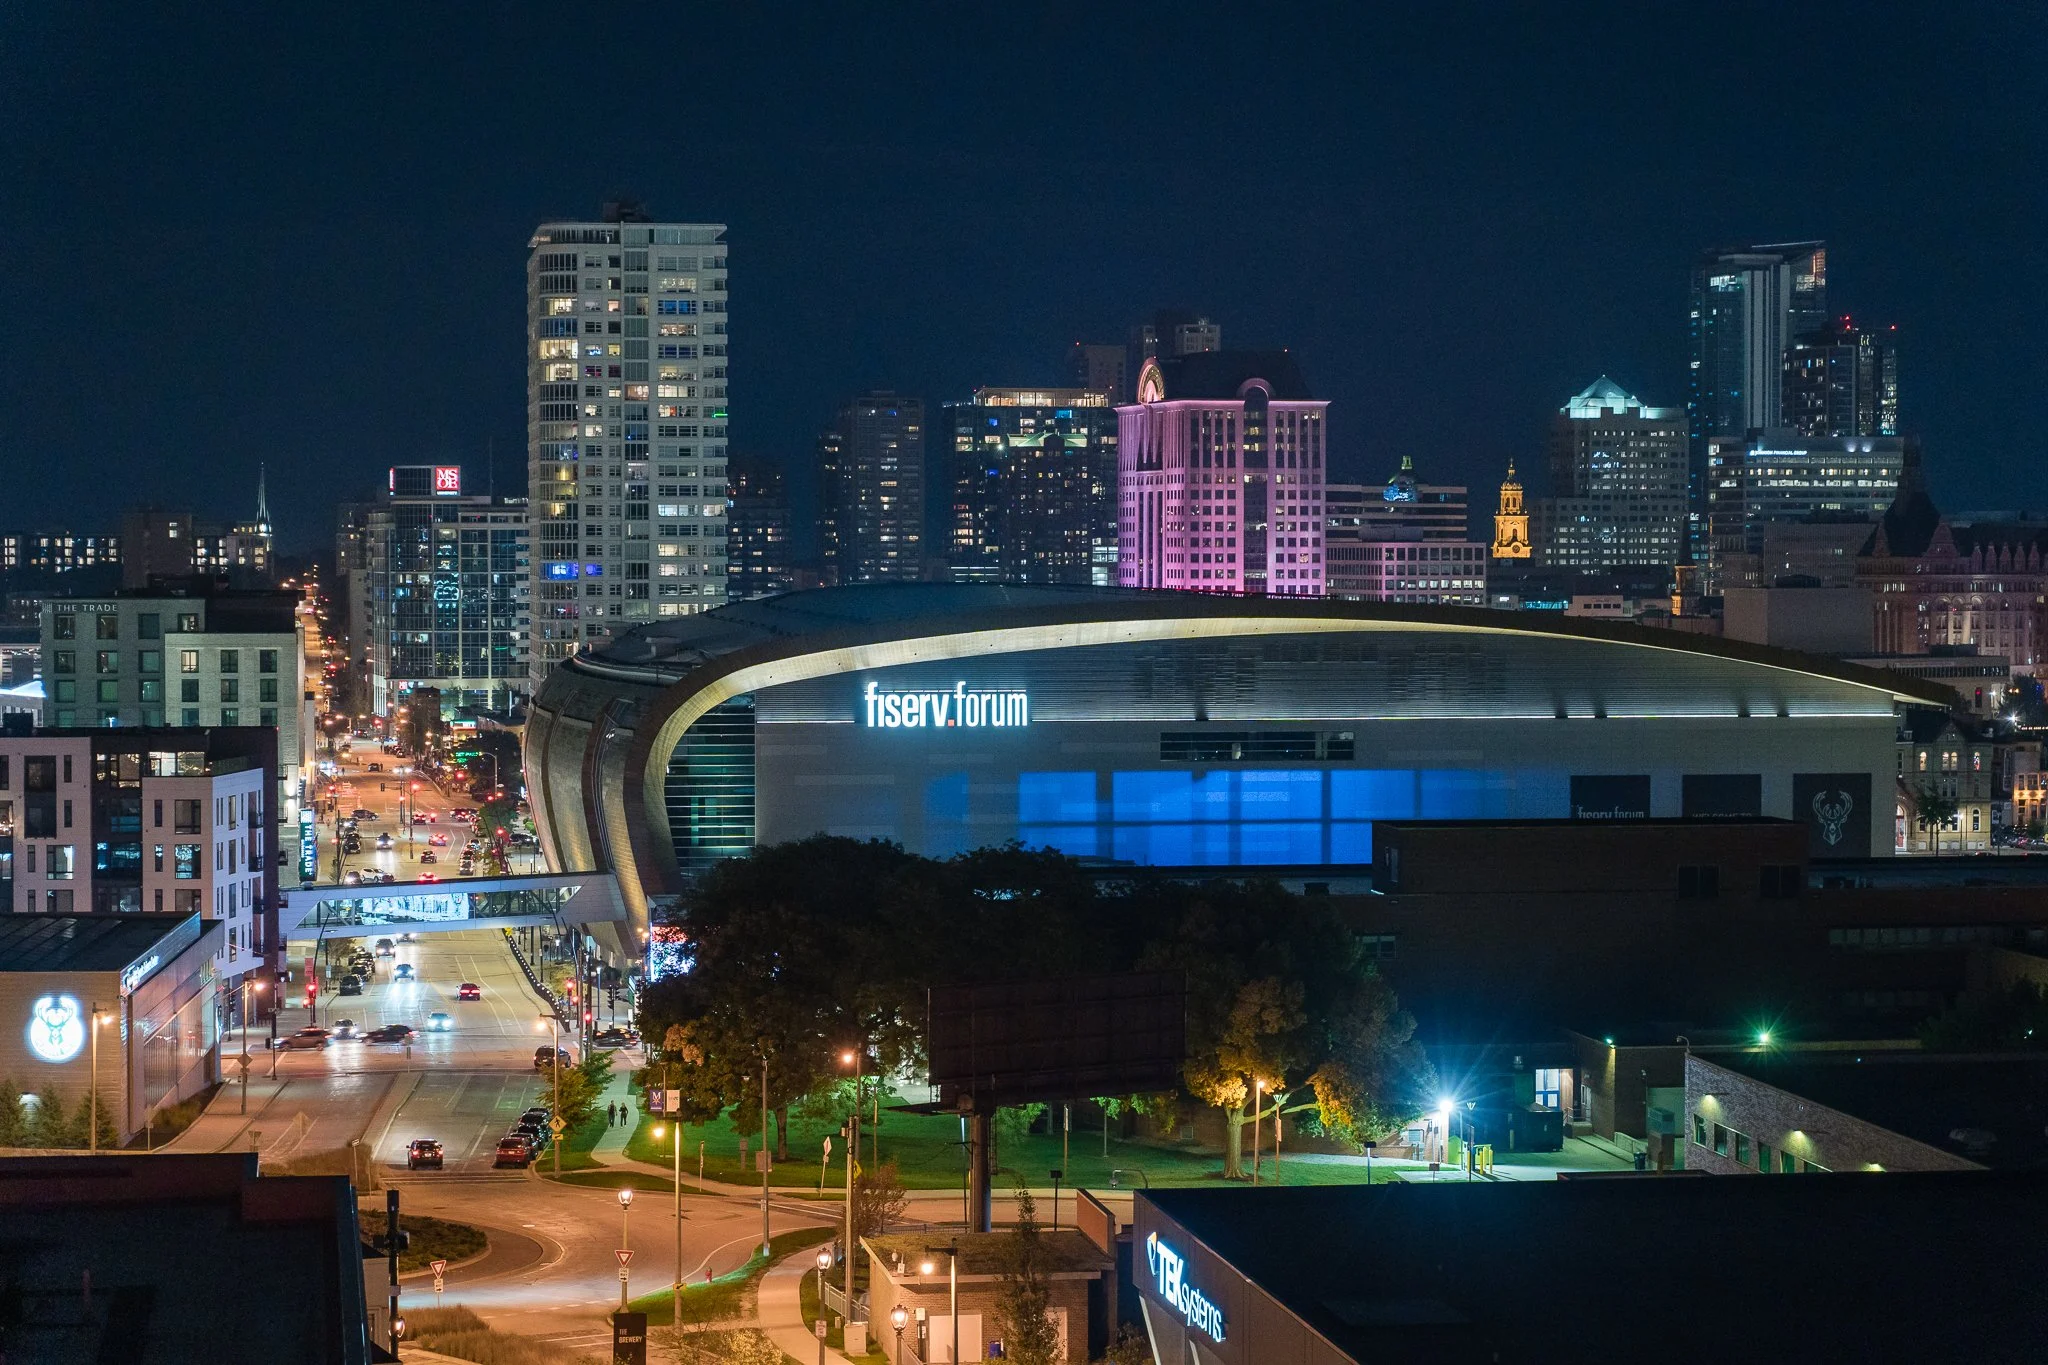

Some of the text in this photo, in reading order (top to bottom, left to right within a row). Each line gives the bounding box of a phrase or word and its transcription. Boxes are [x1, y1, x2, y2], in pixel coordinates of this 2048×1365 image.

[437, 469, 458, 480] MS
[437, 479, 458, 489] OE
[57, 604, 118, 612] THE TRADE
[304, 824, 313, 842] THE
[619, 1328, 628, 1336] THE
[618, 1335, 643, 1344] BREWERY
